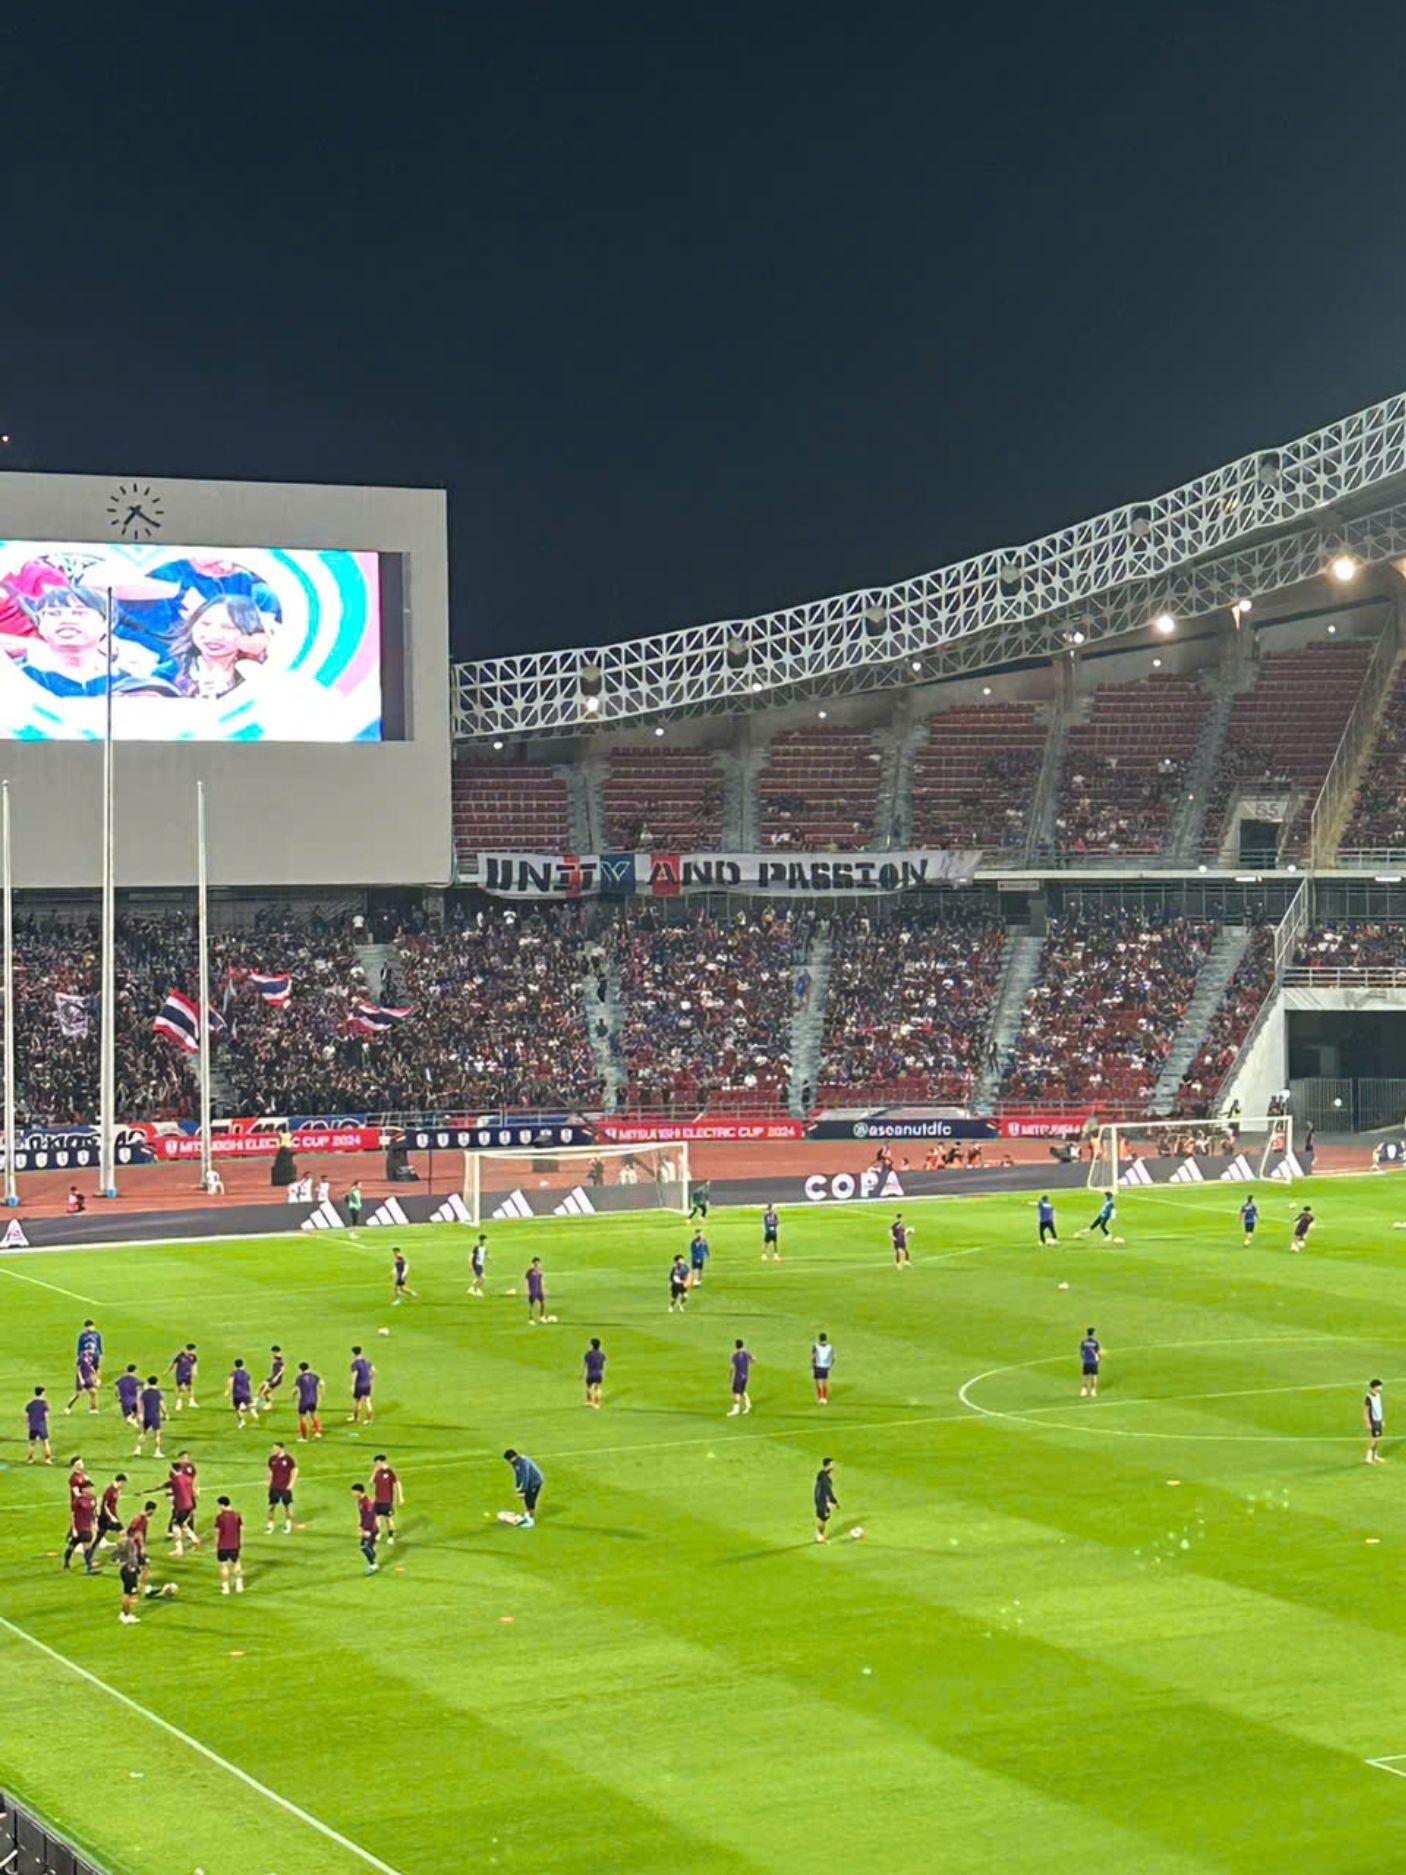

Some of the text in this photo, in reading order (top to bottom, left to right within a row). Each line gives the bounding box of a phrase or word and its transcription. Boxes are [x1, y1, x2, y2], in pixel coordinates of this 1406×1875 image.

[486, 858, 929, 892] UNITY AND PASSION
[302, 1135, 329, 1148] CUP
[332, 1133, 361, 1147] 2024
[682, 1126, 736, 1139] ELECTRIC
[738, 1126, 764, 1138] CUP
[767, 1125, 795, 1138] 2024
[804, 1170, 905, 1201] COPA
